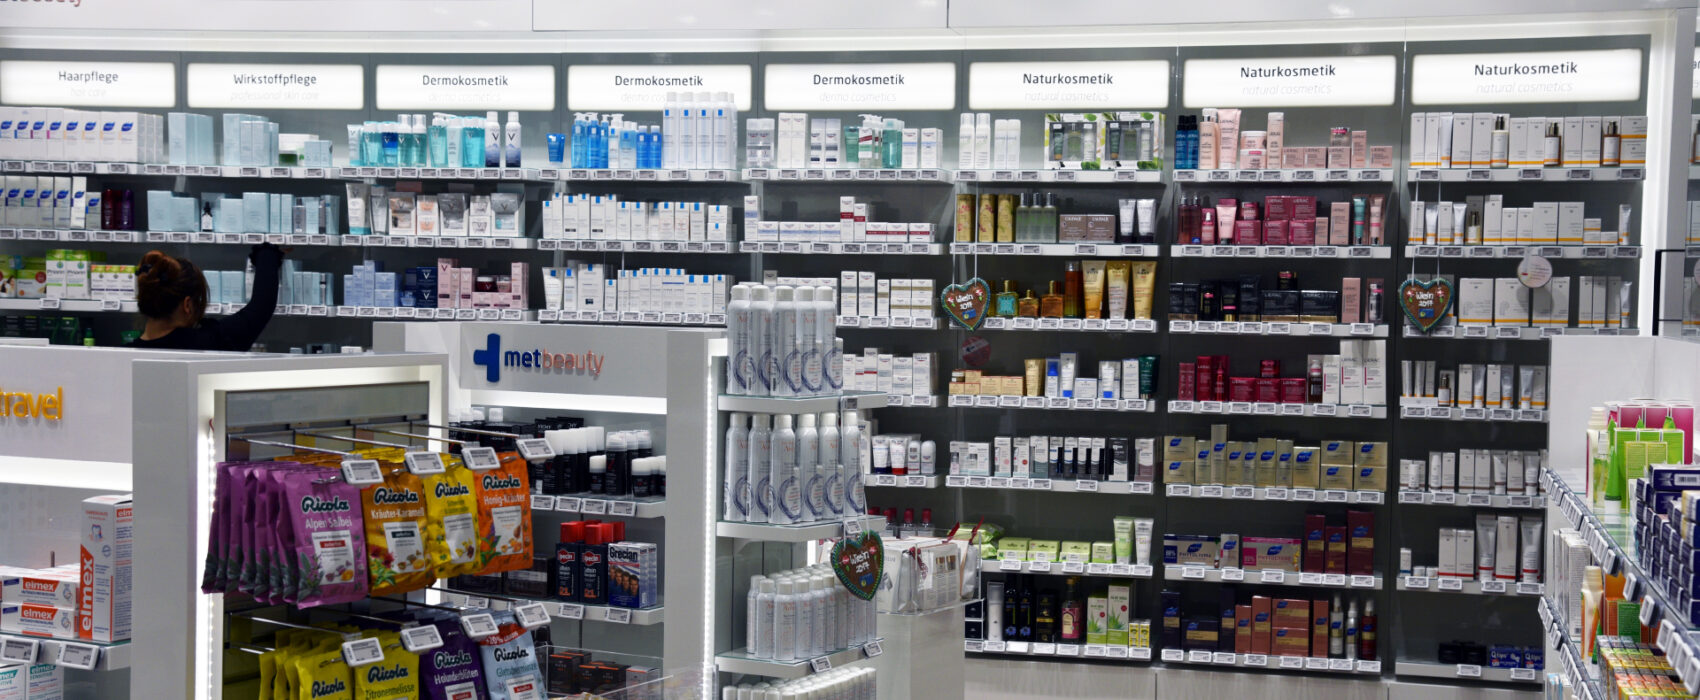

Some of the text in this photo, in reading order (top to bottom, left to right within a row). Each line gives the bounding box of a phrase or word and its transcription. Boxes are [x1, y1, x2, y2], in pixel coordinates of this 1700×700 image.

[58, 70, 119, 84] Haarpflege
[1239, 64, 1336, 79] Naturkosmetik
[1474, 61, 1578, 77] Naturkosmetik
[233, 73, 318, 87] Wirkstoffpflege
[422, 74, 508, 87] Dermokosmetik
[614, 74, 703, 87] Dermokosmetik
[812, 73, 905, 86] Dermokosmetik
[1022, 72, 1114, 86] Naturkosmetik
[504, 348, 604, 377] metbeauty
[0, 386, 62, 420] ravel
[435, 481, 469, 498] Ricola
[483, 475, 521, 491] Ricola
[374, 487, 419, 504] Ricola
[484, 494, 525, 506] Honig-Kräuter
[302, 495, 350, 513] Ricola
[371, 507, 424, 520] Kräuter-Karamell
[305, 518, 327, 530] Alpen
[609, 546, 638, 561] Grecian
[25, 581, 55, 592] elmex
[81, 557, 93, 631] elmex
[23, 609, 53, 619] elmex
[434, 651, 472, 668] Ricola
[494, 645, 530, 662] Ricola
[368, 664, 409, 684] Ricola
[434, 669, 479, 685] Holunderblüten
[311, 678, 345, 699] Ricola
[365, 683, 415, 700] Zitronenmelisse
